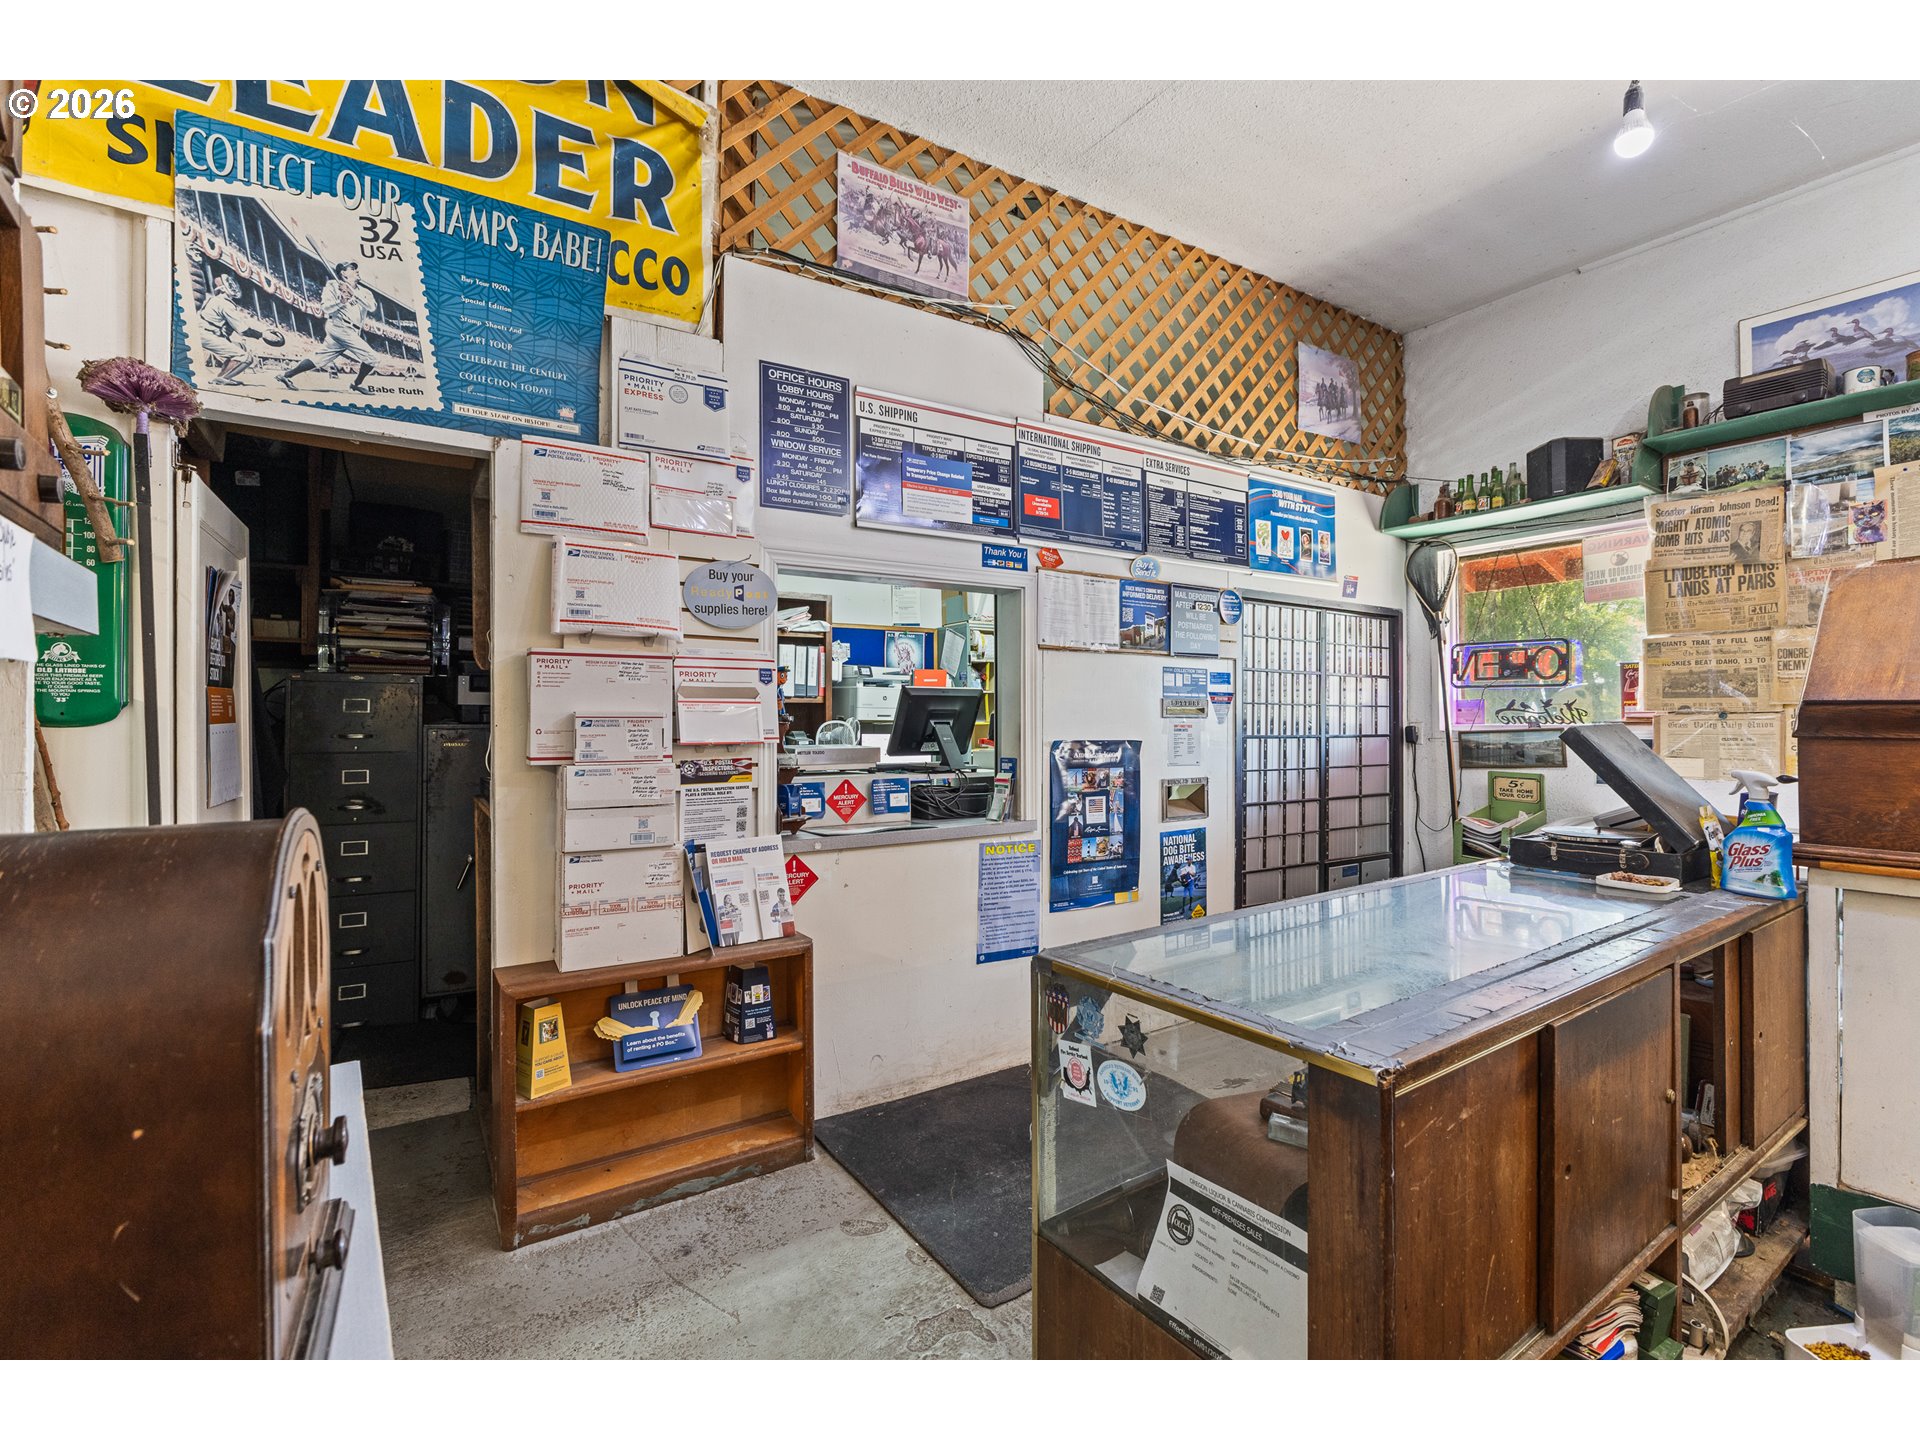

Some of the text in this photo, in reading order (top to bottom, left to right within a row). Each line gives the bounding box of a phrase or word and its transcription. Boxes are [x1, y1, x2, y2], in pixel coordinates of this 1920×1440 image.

[140, 80, 680, 236] EADER
[852, 161, 889, 184] BUFFALO
[890, 175, 913, 193] BILLS
[915, 185, 936, 201] WILD
[937, 193, 958, 209] WEST
[183, 127, 602, 275] COLLECT OUR STAMPS, BABE!
[359, 216, 401, 245] 32
[360, 244, 403, 262] USA
[460, 295, 512, 313] Special Edition
[460, 315, 482, 326] Stamp
[485, 321, 507, 331] Sheets
[460, 334, 513, 350] START YOUR
[460, 353, 568, 381] CELEBRATE THE CENTURY
[459, 372, 552, 396] COLLECTION TODAY!
[624, 374, 664, 387] PRIORITY
[768, 369, 842, 391] OFFICE HOURS
[367, 385, 424, 396] Babe Ruth
[624, 388, 664, 400] EXPRESS
[634, 383, 655, 392] MAIL
[777, 384, 834, 400] LOBBY HOURS
[779, 396, 832, 410] MONDAY FRIDAY
[472, 408, 488, 416] YOUR
[490, 411, 510, 420] STAMP
[512, 415, 523, 423] ON
[790, 413, 822, 423] SATURDAY
[860, 400, 918, 423] U.S. SHIPPING
[1876, 410, 1901, 418] PHOTOS
[794, 427, 819, 436] SUNDAY
[770, 438, 842, 456] WINDOW SERVICE
[1018, 429, 1070, 450] INTERNATIONAL
[1071, 443, 1101, 457] SHIPPING
[655, 456, 693, 468] PRIORITY
[782, 452, 835, 466] MONDAY FRIDAY
[664, 465, 684, 473] MAIL
[790, 469, 823, 478] SATURDAY
[1145, 458, 1191, 477] EXTRA SERVICES
[1279, 499, 1316, 514] WITH STYLE
[1690, 504, 1715, 515] Hiram
[1719, 501, 1751, 512] Johnson
[1755, 496, 1780, 508] Dead!
[1656, 514, 1731, 534] MIGHTY ATOMIC
[83, 531, 96, 539] 100
[1655, 529, 1730, 548] BOMB HITS JAPS
[984, 546, 1022, 558] Thank You
[708, 569, 754, 584] Buy your
[1135, 568, 1150, 577] Send
[1664, 564, 1736, 583] LINDBERGH
[1668, 572, 1776, 599] LANDS AT PARIS
[1122, 590, 1146, 600] INFORMED
[1174, 590, 1218, 601] MAIL DEPOSITED
[694, 604, 768, 616] supplies here!
[1175, 600, 1192, 610] AFTER
[1749, 603, 1778, 614] EXTRA
[1186, 611, 1198, 620] WILL
[1177, 621, 1214, 631] POSTMARKED
[1174, 630, 1186, 639] THE
[1190, 640, 1202, 650] DAY
[1662, 640, 1687, 648] GIANTS
[1777, 648, 1810, 659] CONGRE
[1777, 660, 1806, 672] ENEMY
[1163, 833, 1197, 846] NATIONAL
[710, 850, 732, 858] REQUEST
[732, 848, 751, 856] CHANGE
[758, 844, 780, 852] ADDRESS
[985, 844, 1036, 856] NOTICE
[1163, 843, 1196, 856] DOG BITE
[1727, 842, 1771, 857] Glass
[719, 856, 732, 864] HOLD
[1728, 856, 1764, 870] Plus
[568, 882, 603, 890] PRIORITY
[618, 993, 688, 1011] UNLOCK PEACE OF MIND
[642, 1036, 657, 1045] about
[666, 1032, 686, 1040] benefits
[633, 1044, 652, 1052] renting
[1190, 1178, 1292, 1237] OREGON LIQUOR CANNABIS COMMISSION
[1211, 1206, 1263, 1241] OFF-PREMISES SALES
